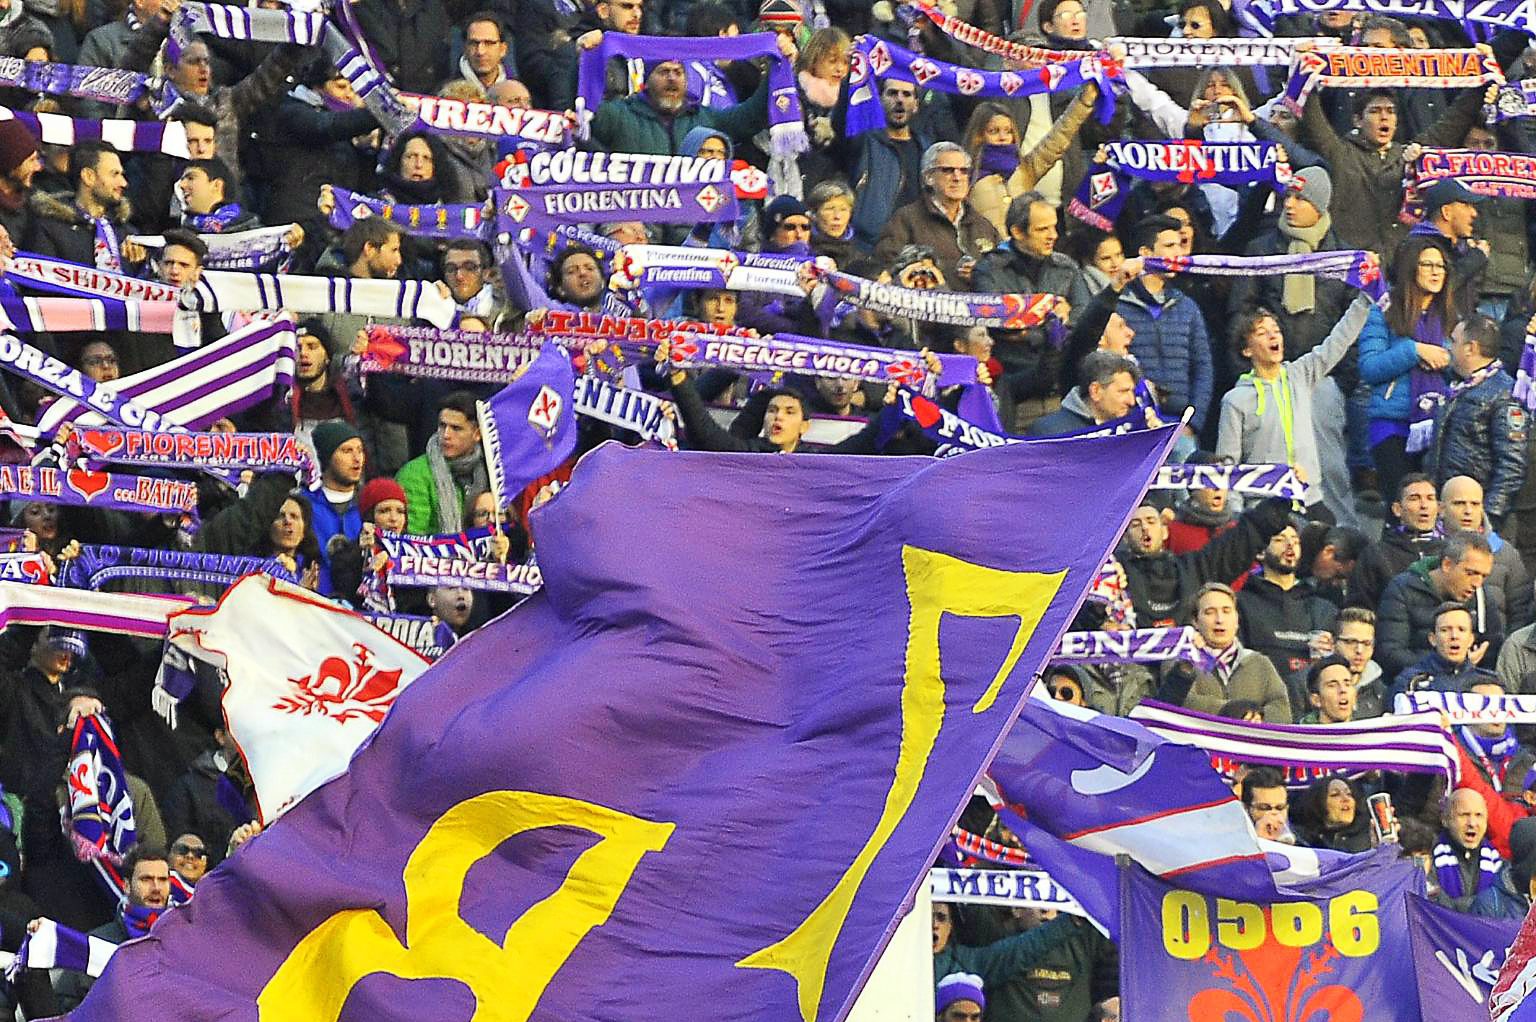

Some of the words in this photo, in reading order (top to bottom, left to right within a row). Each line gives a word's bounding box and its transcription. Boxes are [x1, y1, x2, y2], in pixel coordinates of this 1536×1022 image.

[1330, 52, 1482, 77] FIORENTINA
[544, 187, 682, 215] FIORENTINA
[647, 266, 713, 282] Fiorentina
[705, 339, 809, 369] FIRENZE
[812, 352, 880, 377] VIOLA
[126, 430, 299, 462] FIORENTINA
[400, 553, 501, 581] FIRENZE
